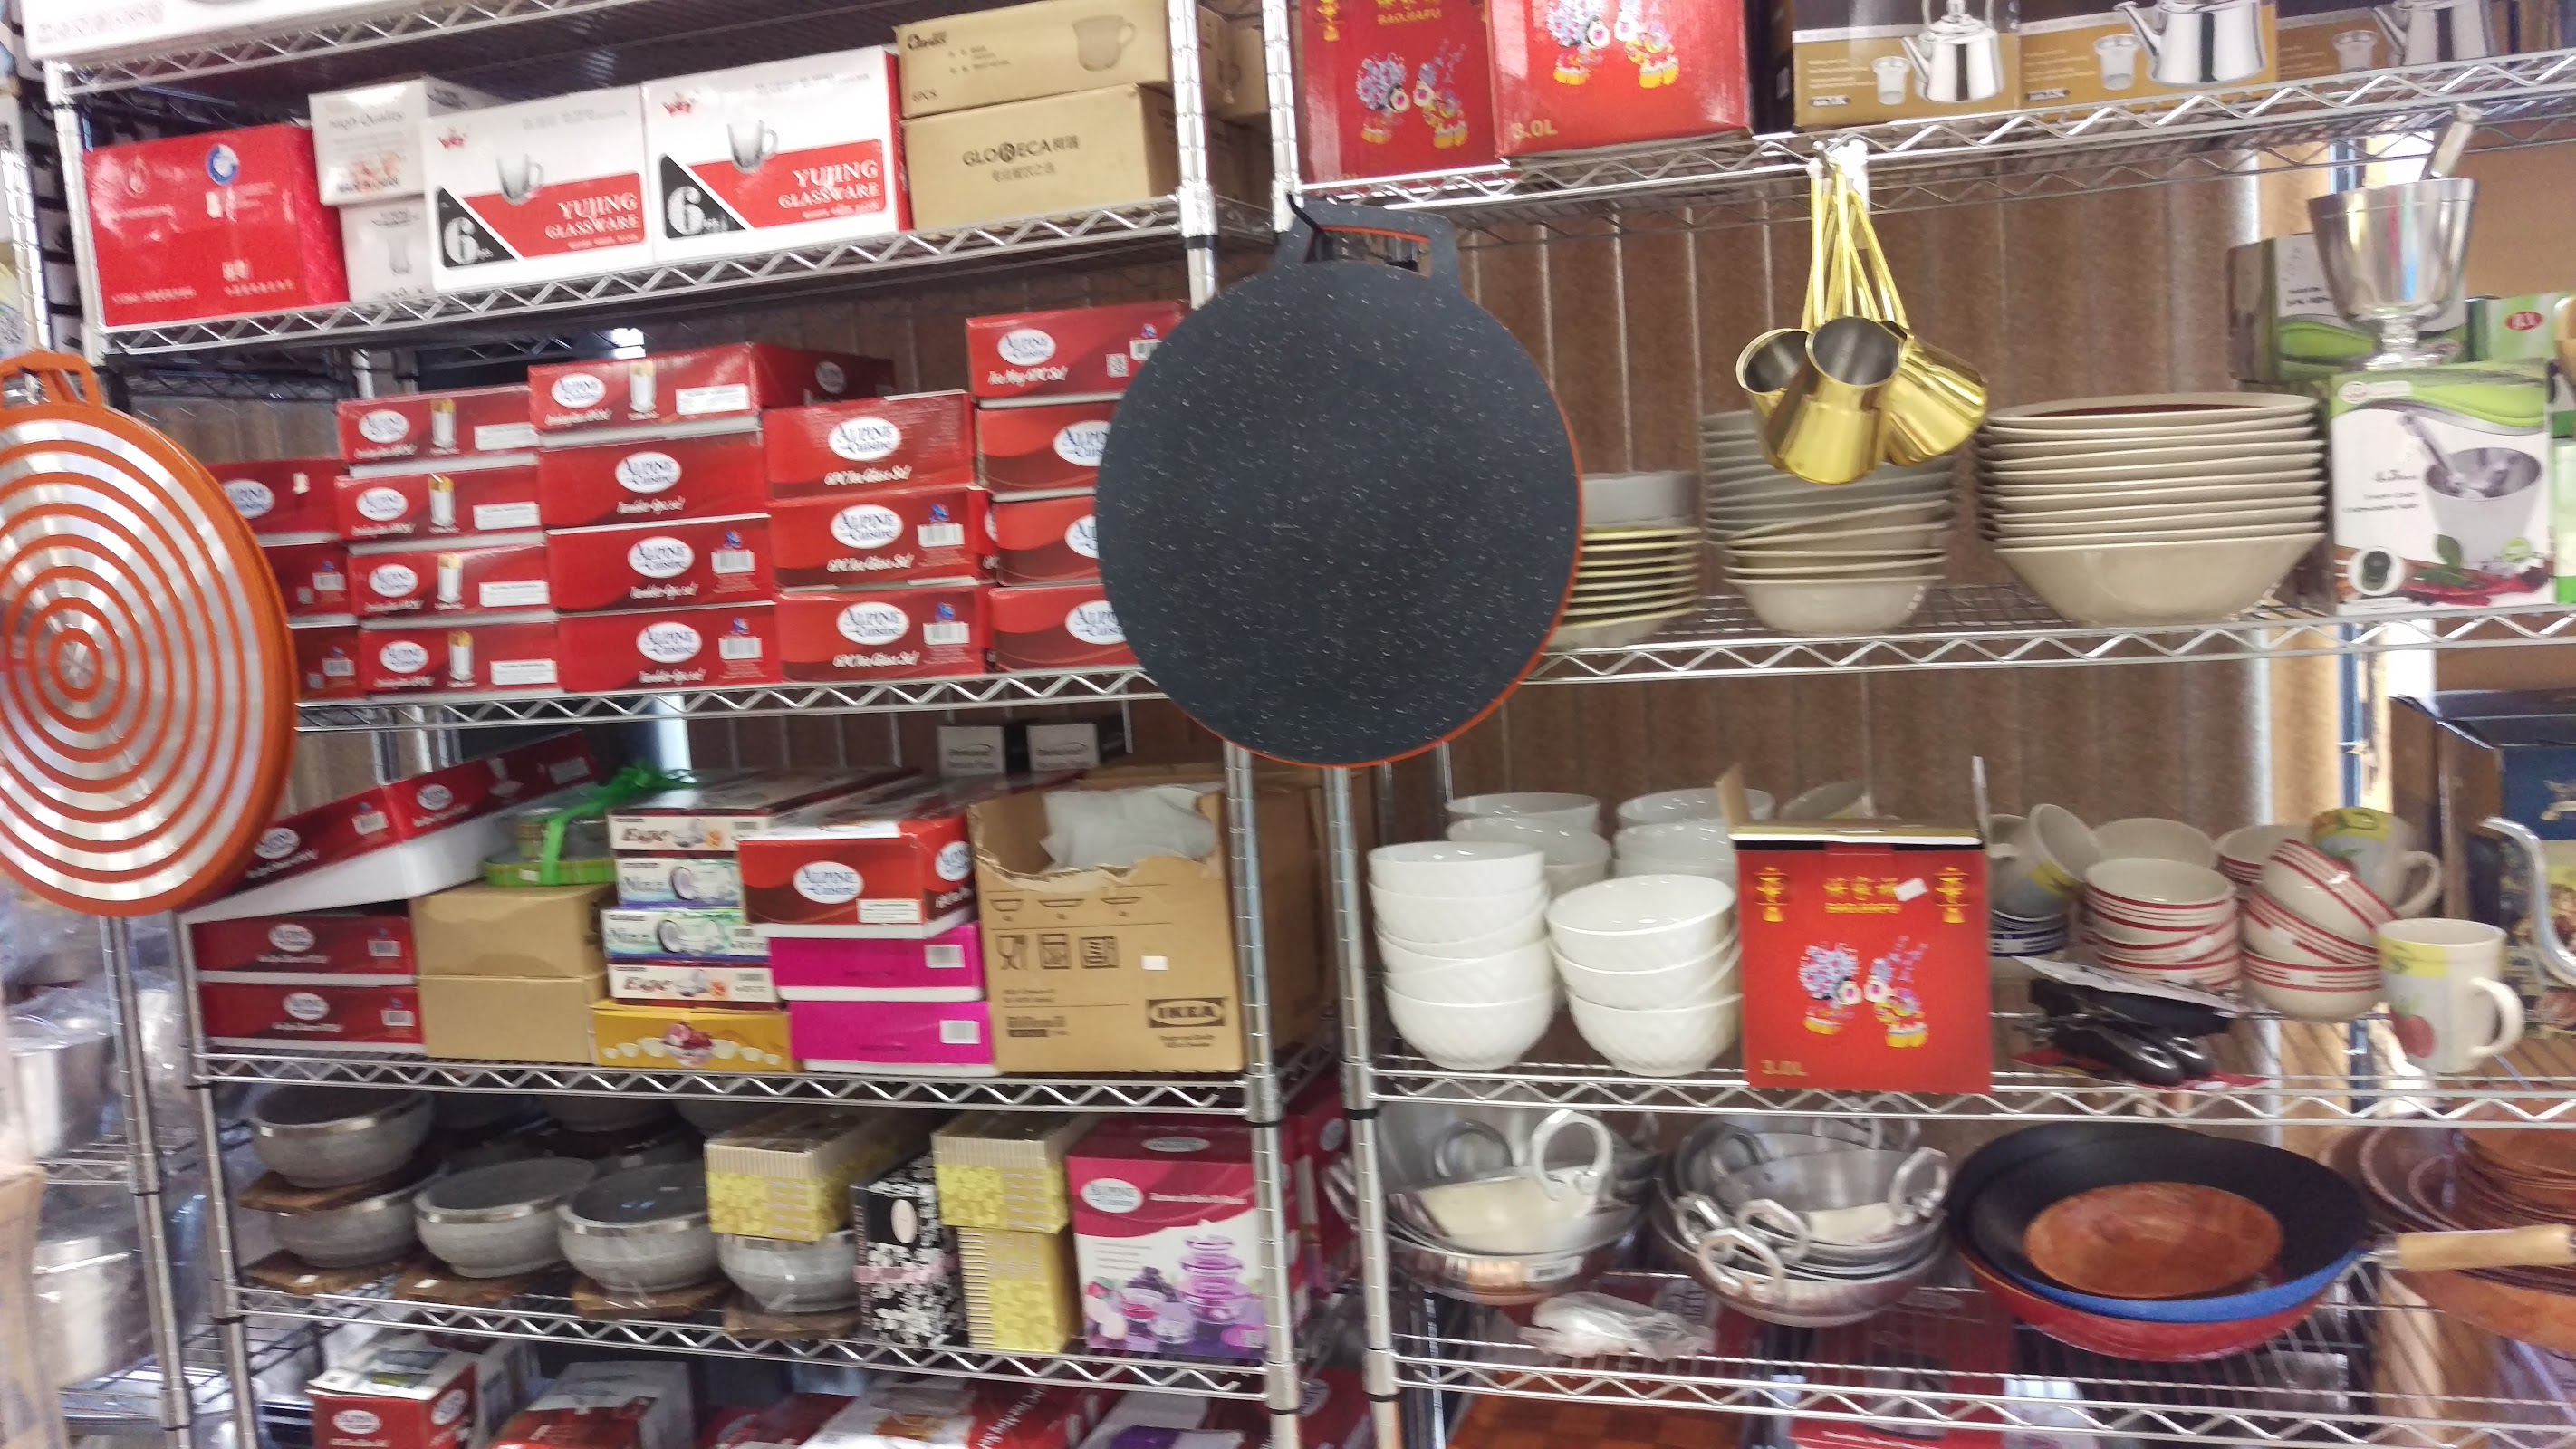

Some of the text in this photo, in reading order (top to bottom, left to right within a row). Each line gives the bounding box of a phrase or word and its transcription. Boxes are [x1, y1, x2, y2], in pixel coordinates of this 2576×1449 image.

[793, 159, 879, 188] YUJING
[557, 192, 639, 220] YUJING
[777, 182, 881, 210] GLASSWARE
[667, 185, 706, 235] 6
[544, 213, 639, 241] GLASSWARE
[444, 216, 480, 265] 6
[837, 425, 893, 442] ALPINE
[840, 513, 894, 530] ALPINE
[845, 610, 901, 627] ALPINE
[801, 869, 856, 886] ALPINE
[805, 885, 855, 897] Cuisine
[1158, 1005, 1216, 1019] IKEA
